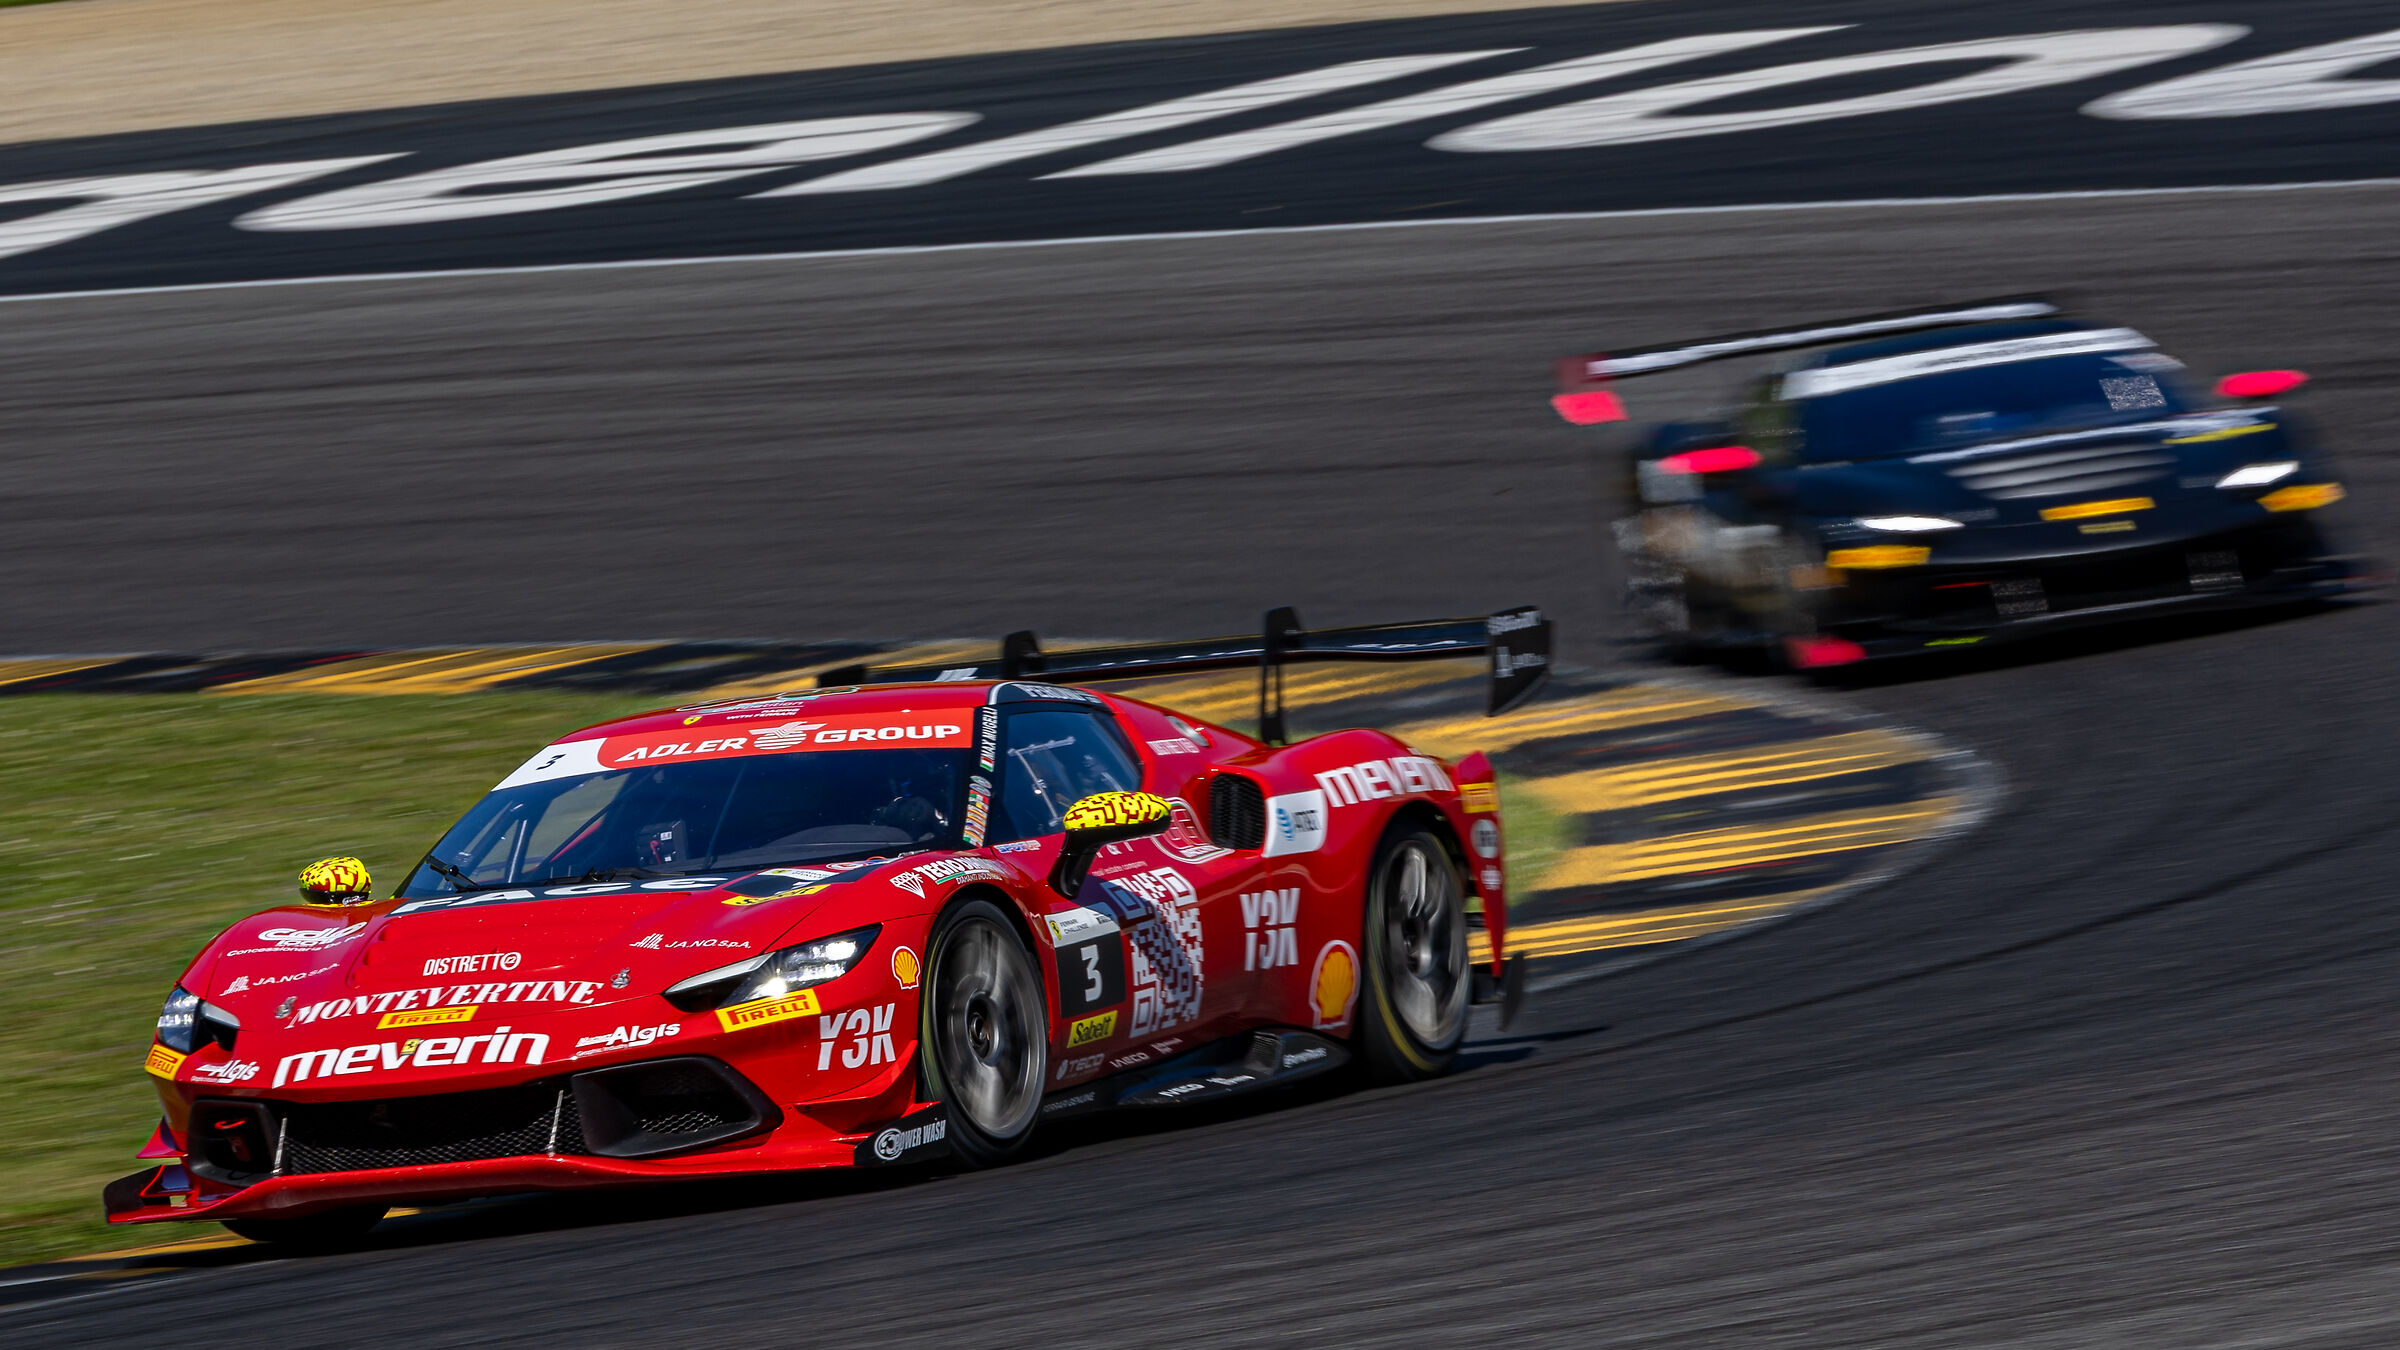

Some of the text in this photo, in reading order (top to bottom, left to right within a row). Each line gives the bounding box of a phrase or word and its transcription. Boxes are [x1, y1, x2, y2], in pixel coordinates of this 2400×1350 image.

[614, 725, 961, 763] ADLER GROUP
[980, 706, 998, 761] MAX MUGELLI
[536, 754, 567, 771] 3
[1239, 887, 1301, 972] Y3K
[226, 946, 322, 957] Concessionaria
[1081, 944, 1103, 1003] 3
[284, 980, 605, 1030] MONTEVERTINE
[726, 994, 810, 1026] PIRELLI
[606, 1023, 681, 1047] Algis
[817, 1002, 896, 1071] Y3K
[1072, 1015, 1113, 1044] Sabelt
[208, 1059, 260, 1084] Algis
[271, 1025, 550, 1089] meverin
[923, 1119, 946, 1144] WASH
